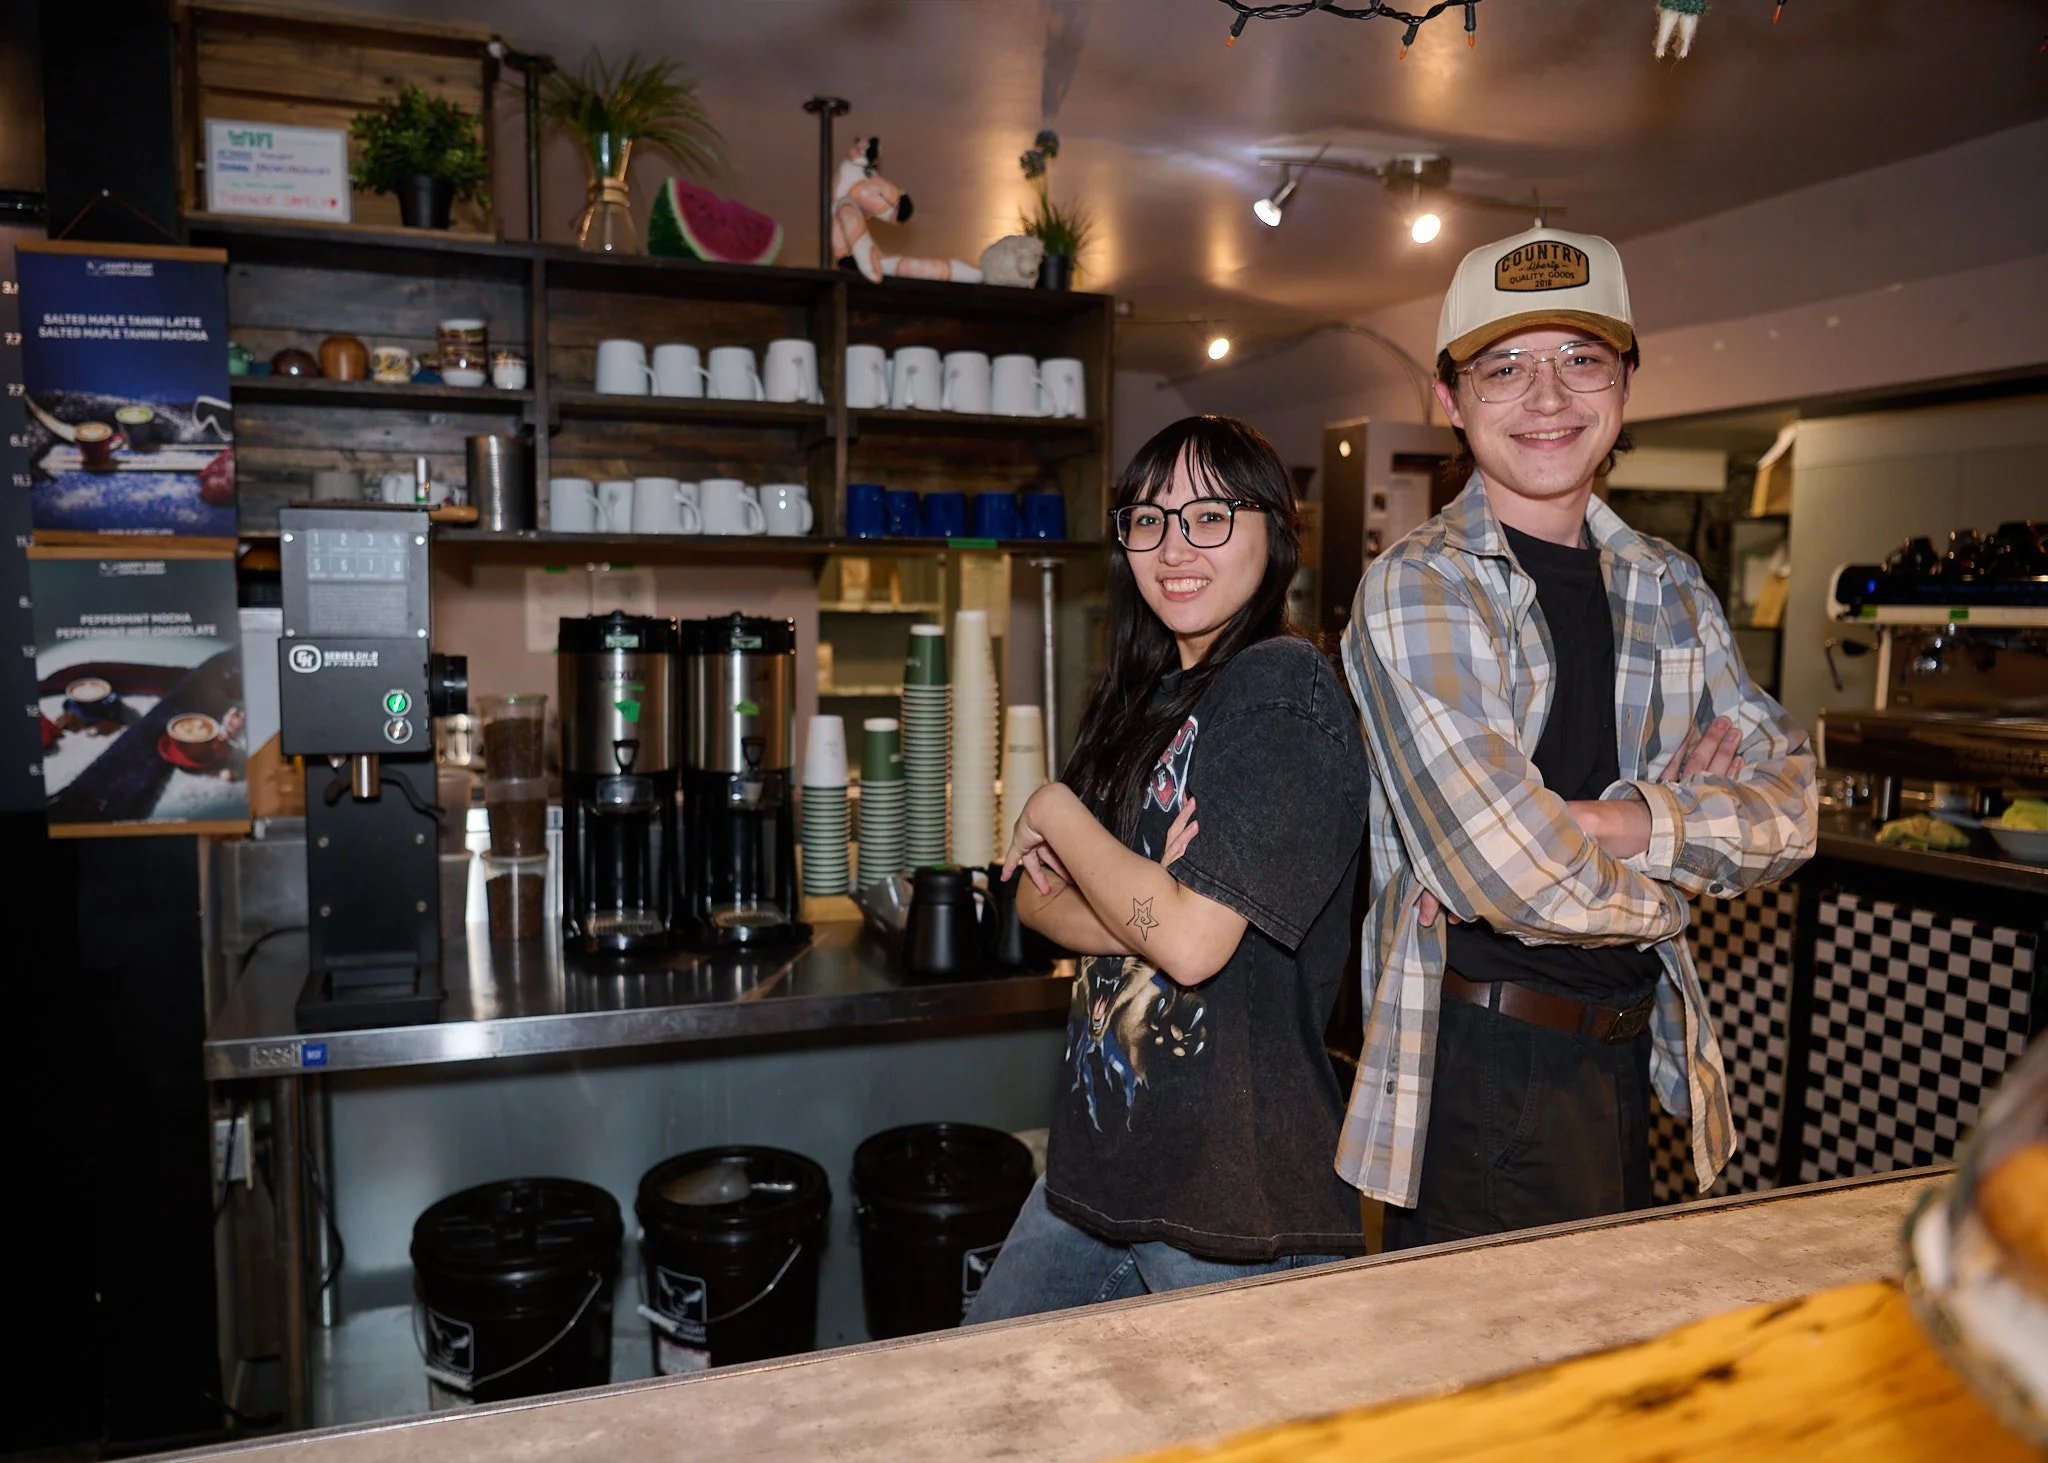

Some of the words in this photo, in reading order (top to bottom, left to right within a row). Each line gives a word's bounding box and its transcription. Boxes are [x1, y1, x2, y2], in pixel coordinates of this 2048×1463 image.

[1501, 244, 1582, 273] COUNTRY
[1509, 272, 1544, 284] QUALITY
[1548, 271, 1576, 280] GOODS
[43, 313, 87, 326] SALTED
[88, 314, 126, 327] MAPLE
[166, 316, 202, 329] LATTE
[38, 326, 82, 339] SALTED
[83, 327, 121, 340] MAPLE
[340, 532, 348, 547] 2
[367, 533, 375, 547] 3
[80, 613, 150, 626] PEPPERMINT
[151, 612, 192, 625] MOCHA
[55, 626, 125, 639] PEPPERMINT
